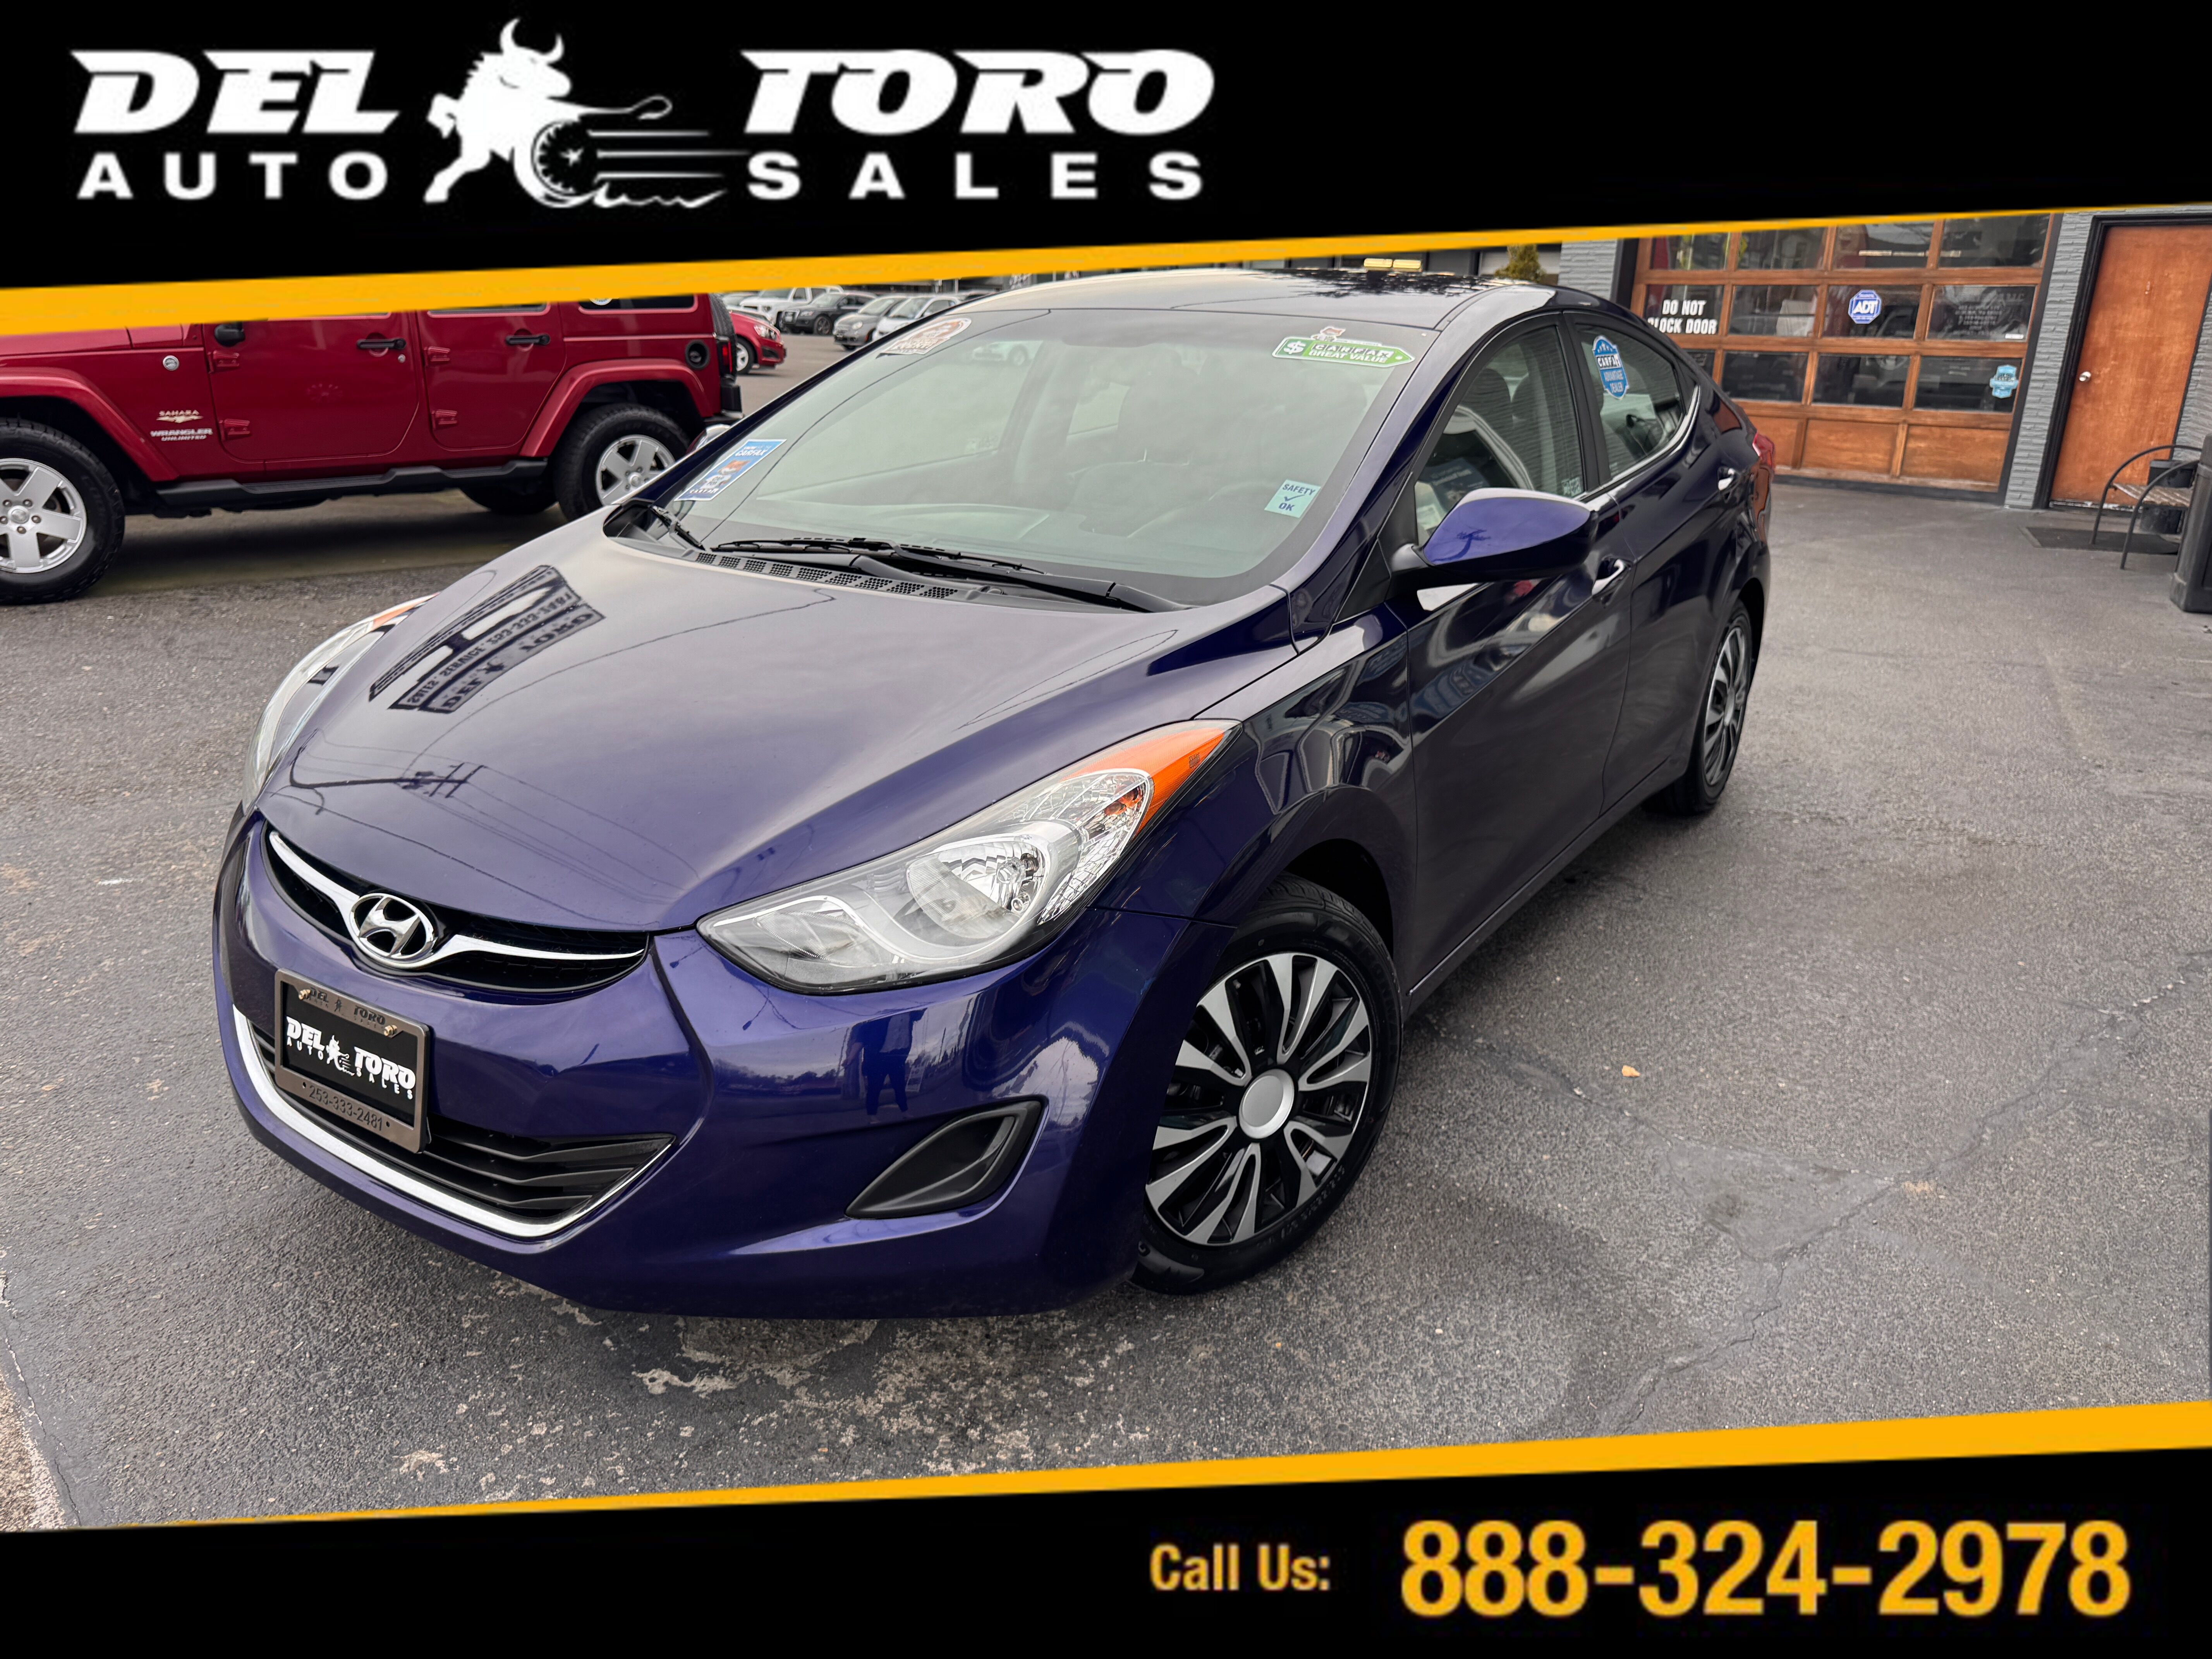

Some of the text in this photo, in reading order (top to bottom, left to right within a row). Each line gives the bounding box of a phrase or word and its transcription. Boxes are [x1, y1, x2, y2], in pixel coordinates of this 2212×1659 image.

[1662, 299, 1707, 316] DO NOT
[1853, 301, 1878, 314] ADT
[1685, 318, 1717, 334] DOOR
[1309, 349, 1388, 363] GREAT VALUE
[1315, 344, 1394, 358] CARFAX
[1597, 354, 1621, 367] CARFAX
[150, 428, 213, 437] WRANGLER
[1283, 484, 1316, 495] SAFETY
[1279, 503, 1295, 511] OK
[354, 1005, 386, 1025] TORO
[287, 1016, 416, 1089] DEL TORO
[287, 1037, 413, 1100] AUTO SALES
[309, 1085, 383, 1131] 253-333-2481
